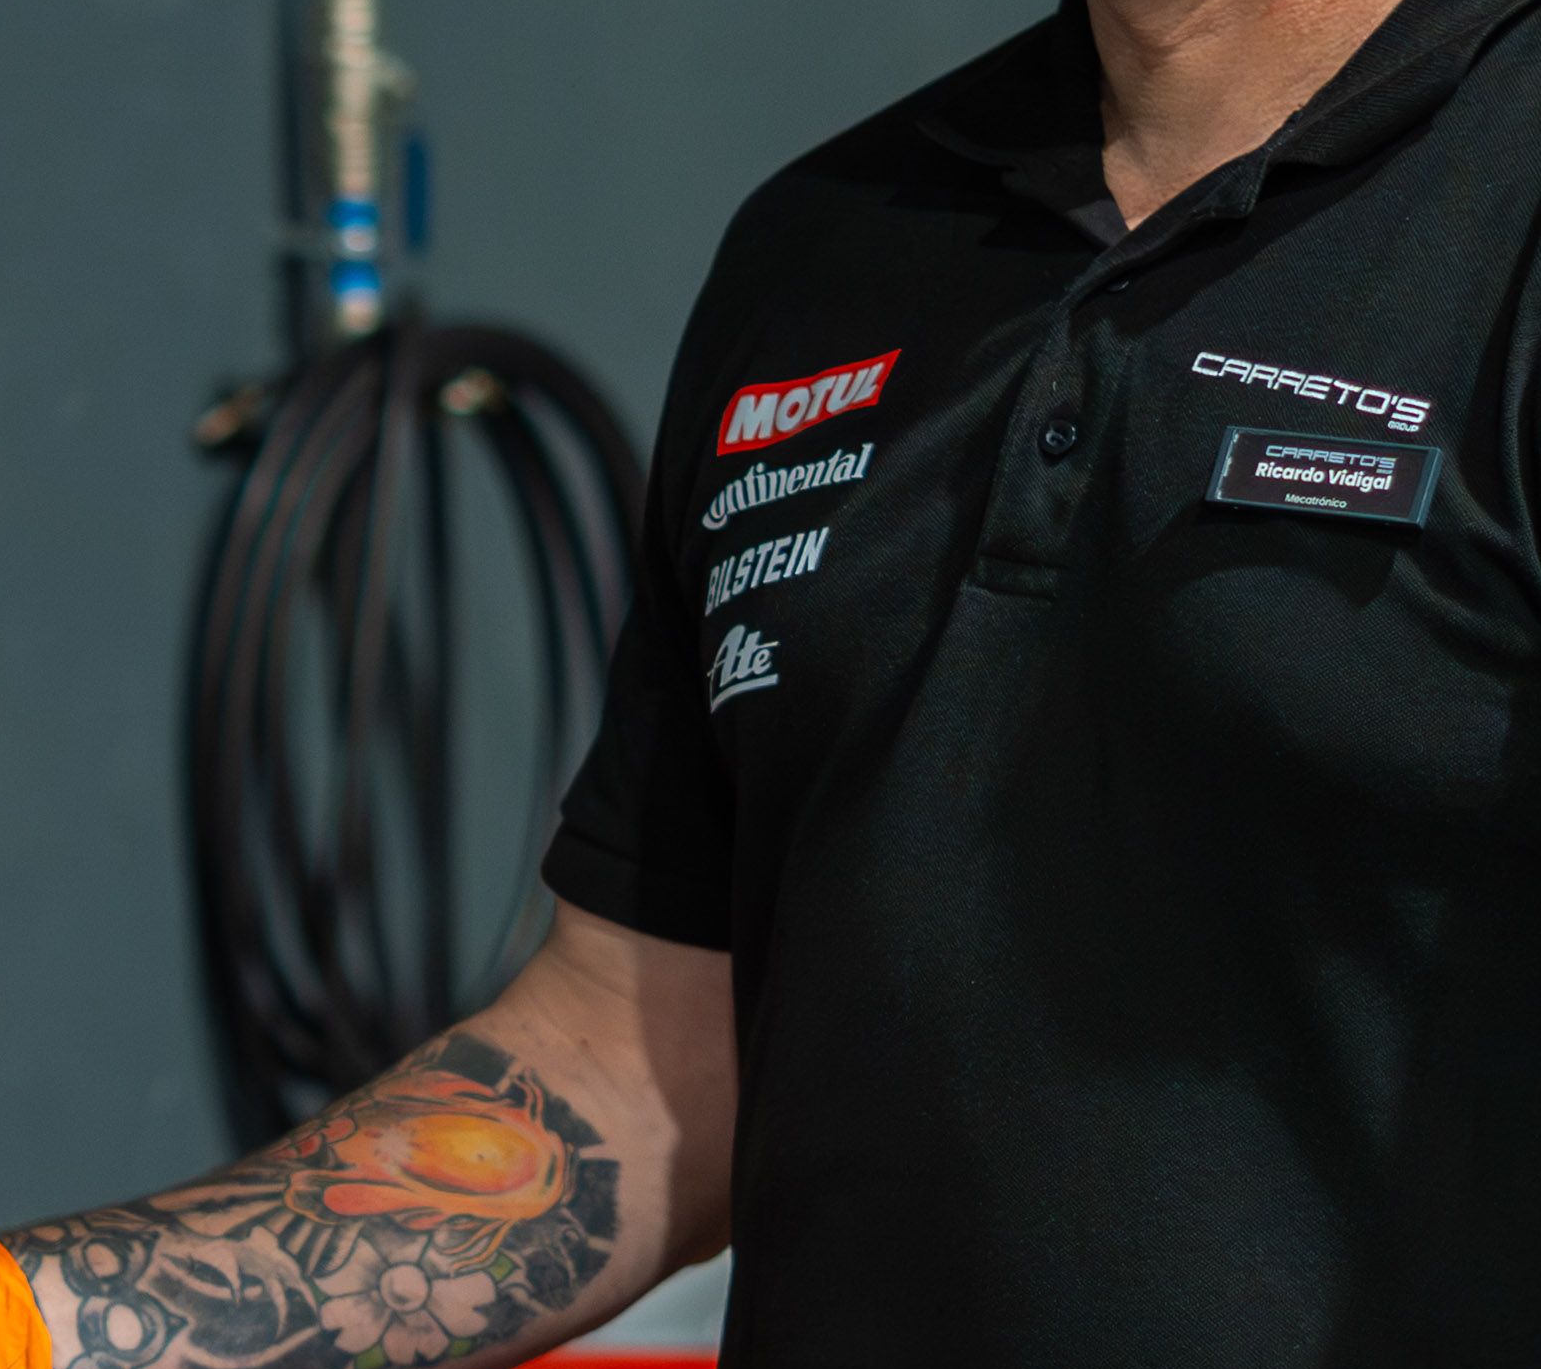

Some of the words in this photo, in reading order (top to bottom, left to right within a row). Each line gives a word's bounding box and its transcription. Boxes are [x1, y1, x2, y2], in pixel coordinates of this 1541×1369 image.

[725, 362, 885, 444] MOTUL
[1192, 351, 1431, 423] CARRETO'S
[1255, 462, 1325, 484] Ricardo
[1328, 469, 1393, 492] Vidigal
[1265, 445, 1399, 469] CARRETO'S
[1284, 493, 1348, 509] Mecatrónico
[705, 526, 830, 617] BILSTEIN
